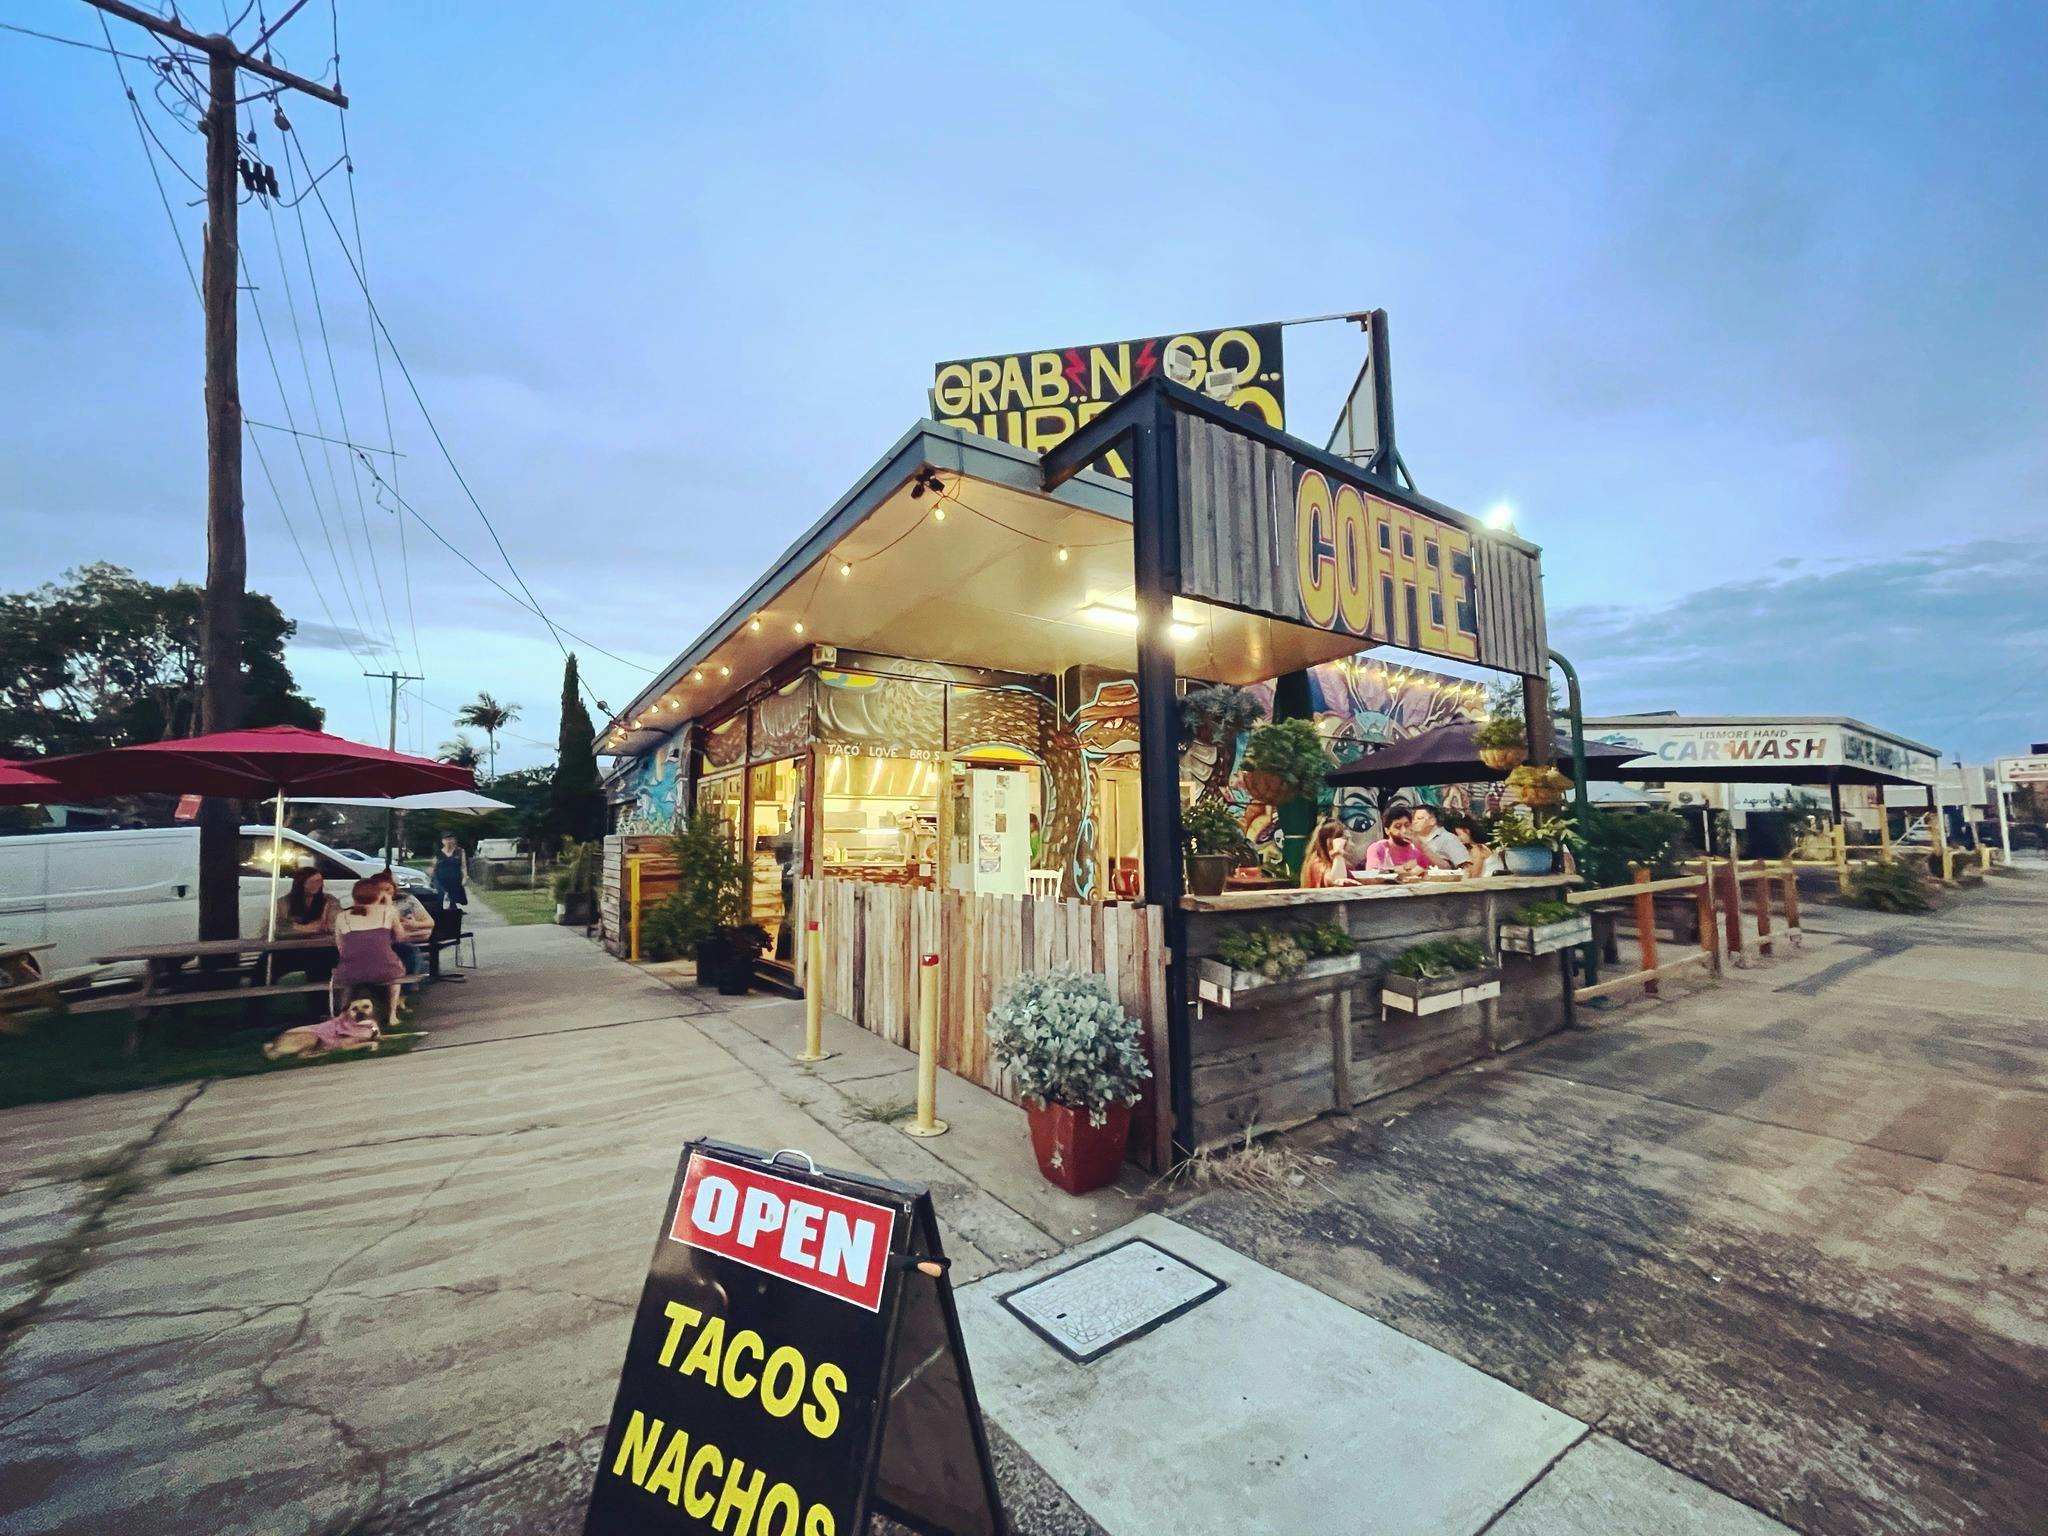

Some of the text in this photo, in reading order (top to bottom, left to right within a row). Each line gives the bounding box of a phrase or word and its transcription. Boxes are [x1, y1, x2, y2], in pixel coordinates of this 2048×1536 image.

[1090, 343, 1132, 400] N
[1296, 469, 1479, 662] COFFEE
[869, 746, 898, 758] LOVE
[1659, 740, 1721, 761] CAR
[1727, 738, 1827, 761] WASH
[1700, 729, 1788, 740] LISMORE HAND
[691, 1176, 875, 1286] OPEN
[658, 1300, 847, 1439] TACOS
